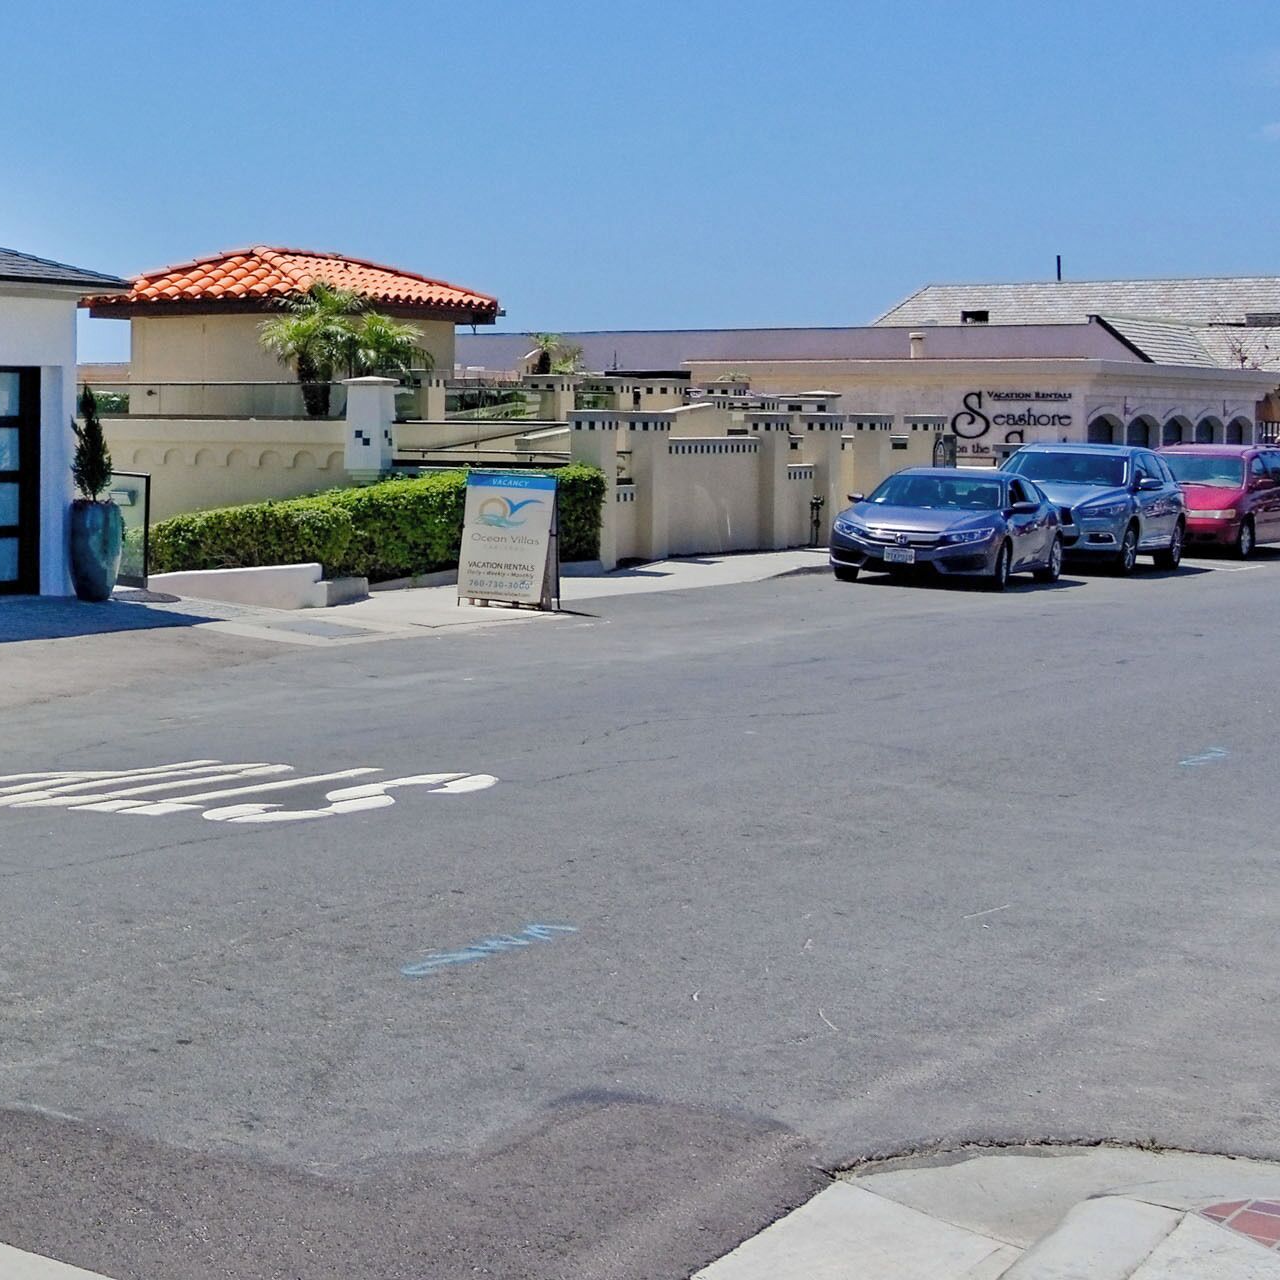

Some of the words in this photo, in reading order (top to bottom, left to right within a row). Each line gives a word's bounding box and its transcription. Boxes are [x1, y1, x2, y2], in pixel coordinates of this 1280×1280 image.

[987, 391, 1031, 399] VACATION
[1034, 391, 1072, 400] RENTALS
[951, 391, 1072, 440] Seashore
[972, 443, 990, 454] the
[492, 479, 529, 487] VACANCY
[471, 532, 507, 543] Ocean
[510, 535, 540, 545] Villas
[468, 561, 503, 569] VACATION
[503, 563, 535, 572] RENTALS
